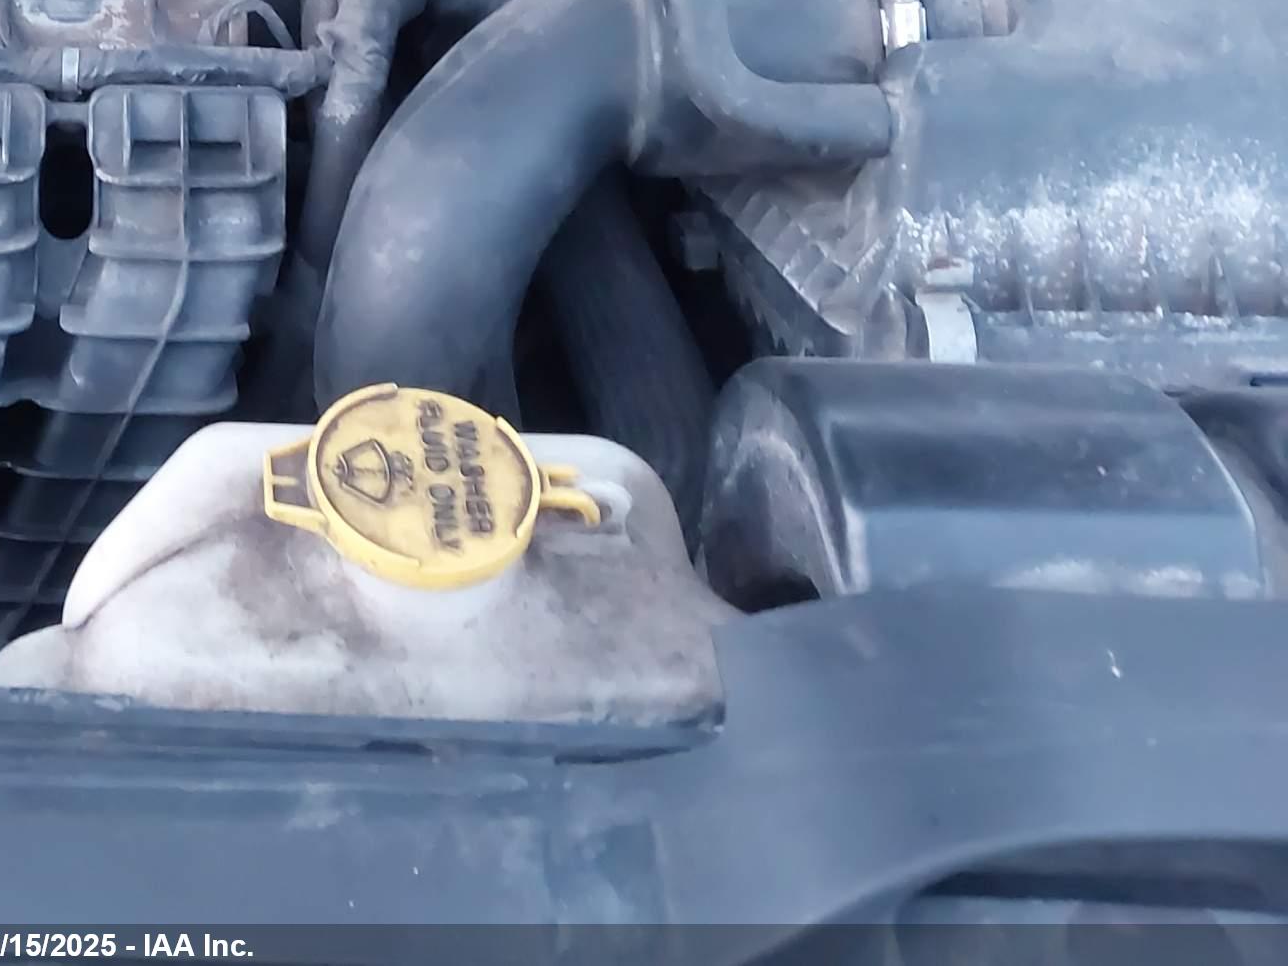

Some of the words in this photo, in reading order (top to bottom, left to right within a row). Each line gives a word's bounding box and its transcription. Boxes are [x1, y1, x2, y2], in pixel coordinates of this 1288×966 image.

[415, 397, 450, 474] FLUID
[453, 419, 496, 536] WASHER
[426, 482, 464, 552] ONLY
